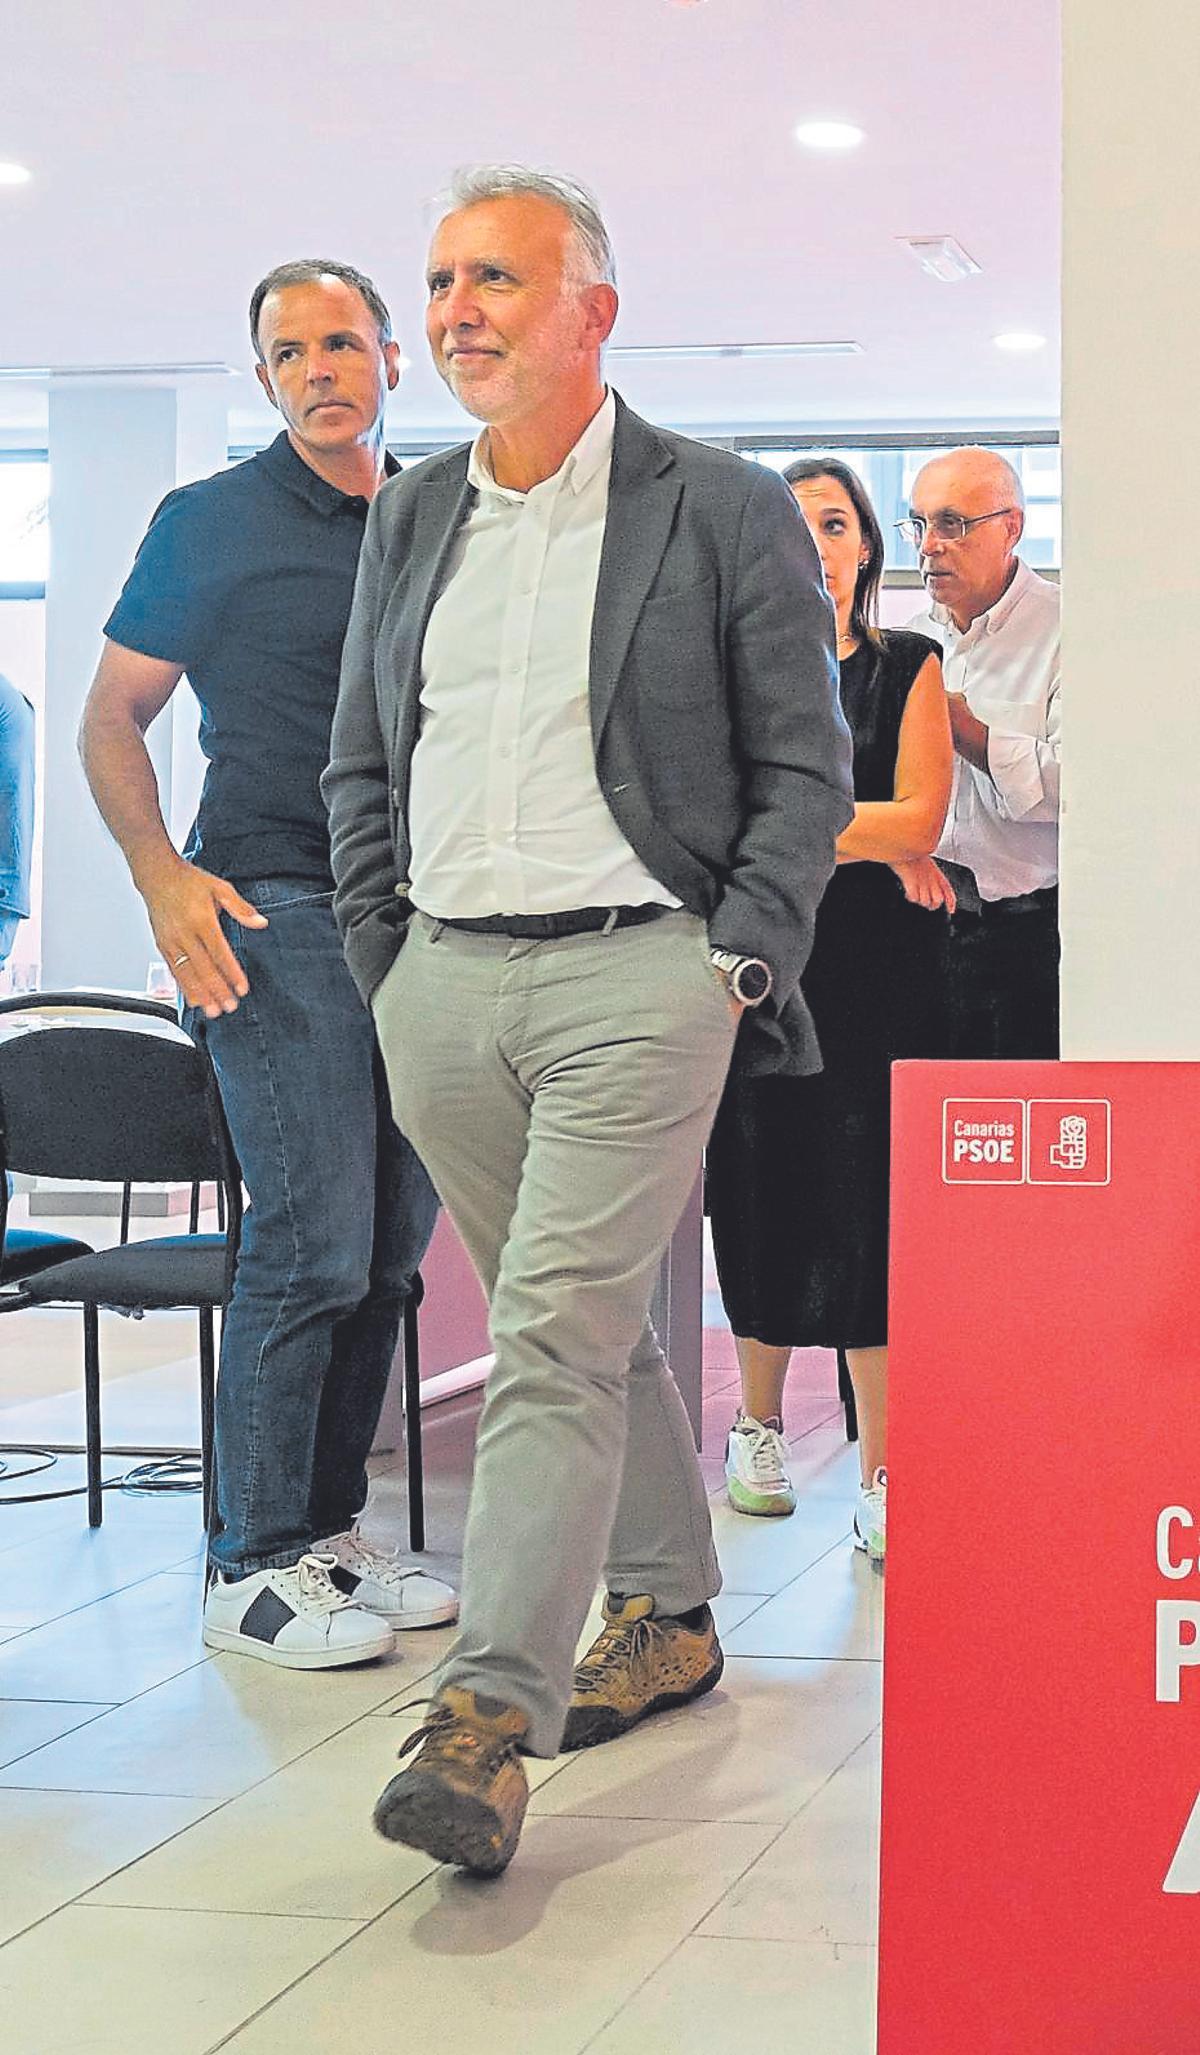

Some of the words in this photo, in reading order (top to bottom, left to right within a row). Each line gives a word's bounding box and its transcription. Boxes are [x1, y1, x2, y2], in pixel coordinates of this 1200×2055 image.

[954, 1119, 1015, 1138] Canarias
[953, 1139, 1015, 1163] PSOE
[1156, 1505, 1200, 1580] C
